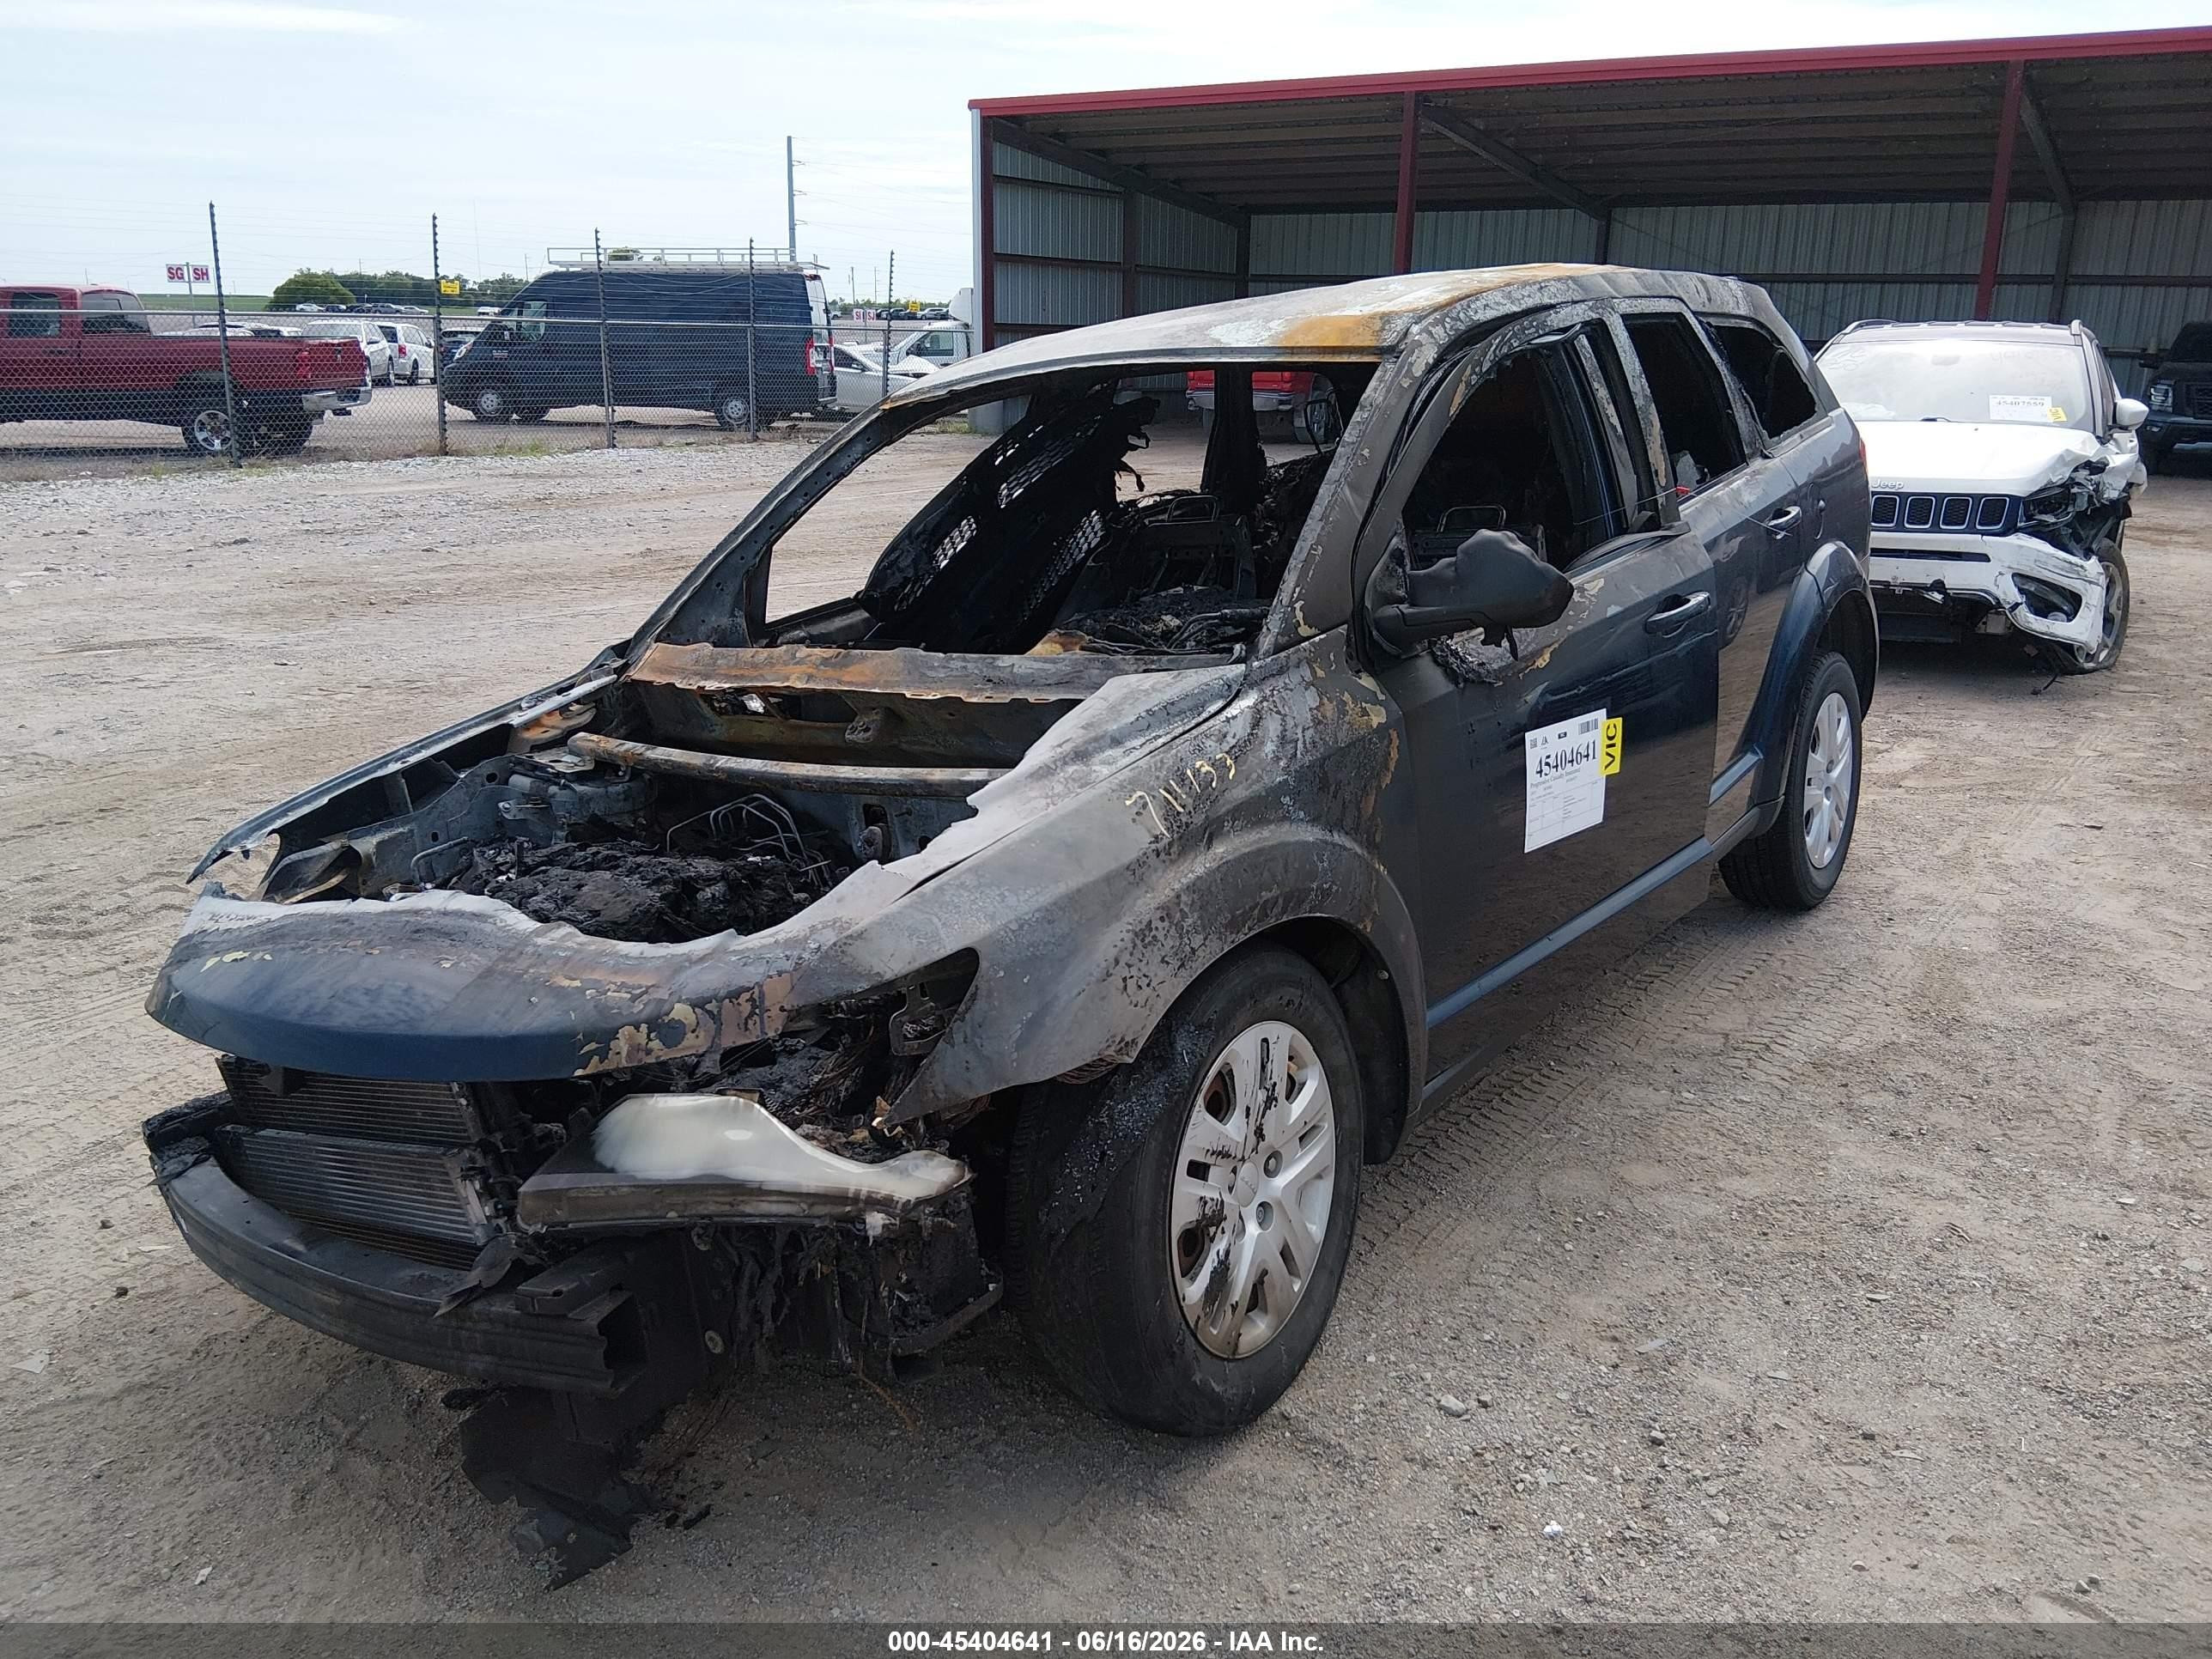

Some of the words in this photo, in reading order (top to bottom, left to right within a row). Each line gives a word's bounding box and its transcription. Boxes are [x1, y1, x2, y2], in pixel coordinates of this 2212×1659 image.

[167, 266, 185, 280] SG
[192, 268, 210, 281] SH
[2049, 409, 2062, 420] VIC
[1872, 478, 1905, 489] Jeep
[1604, 722, 1617, 770] VIC
[1535, 739, 1596, 778] 45404641
